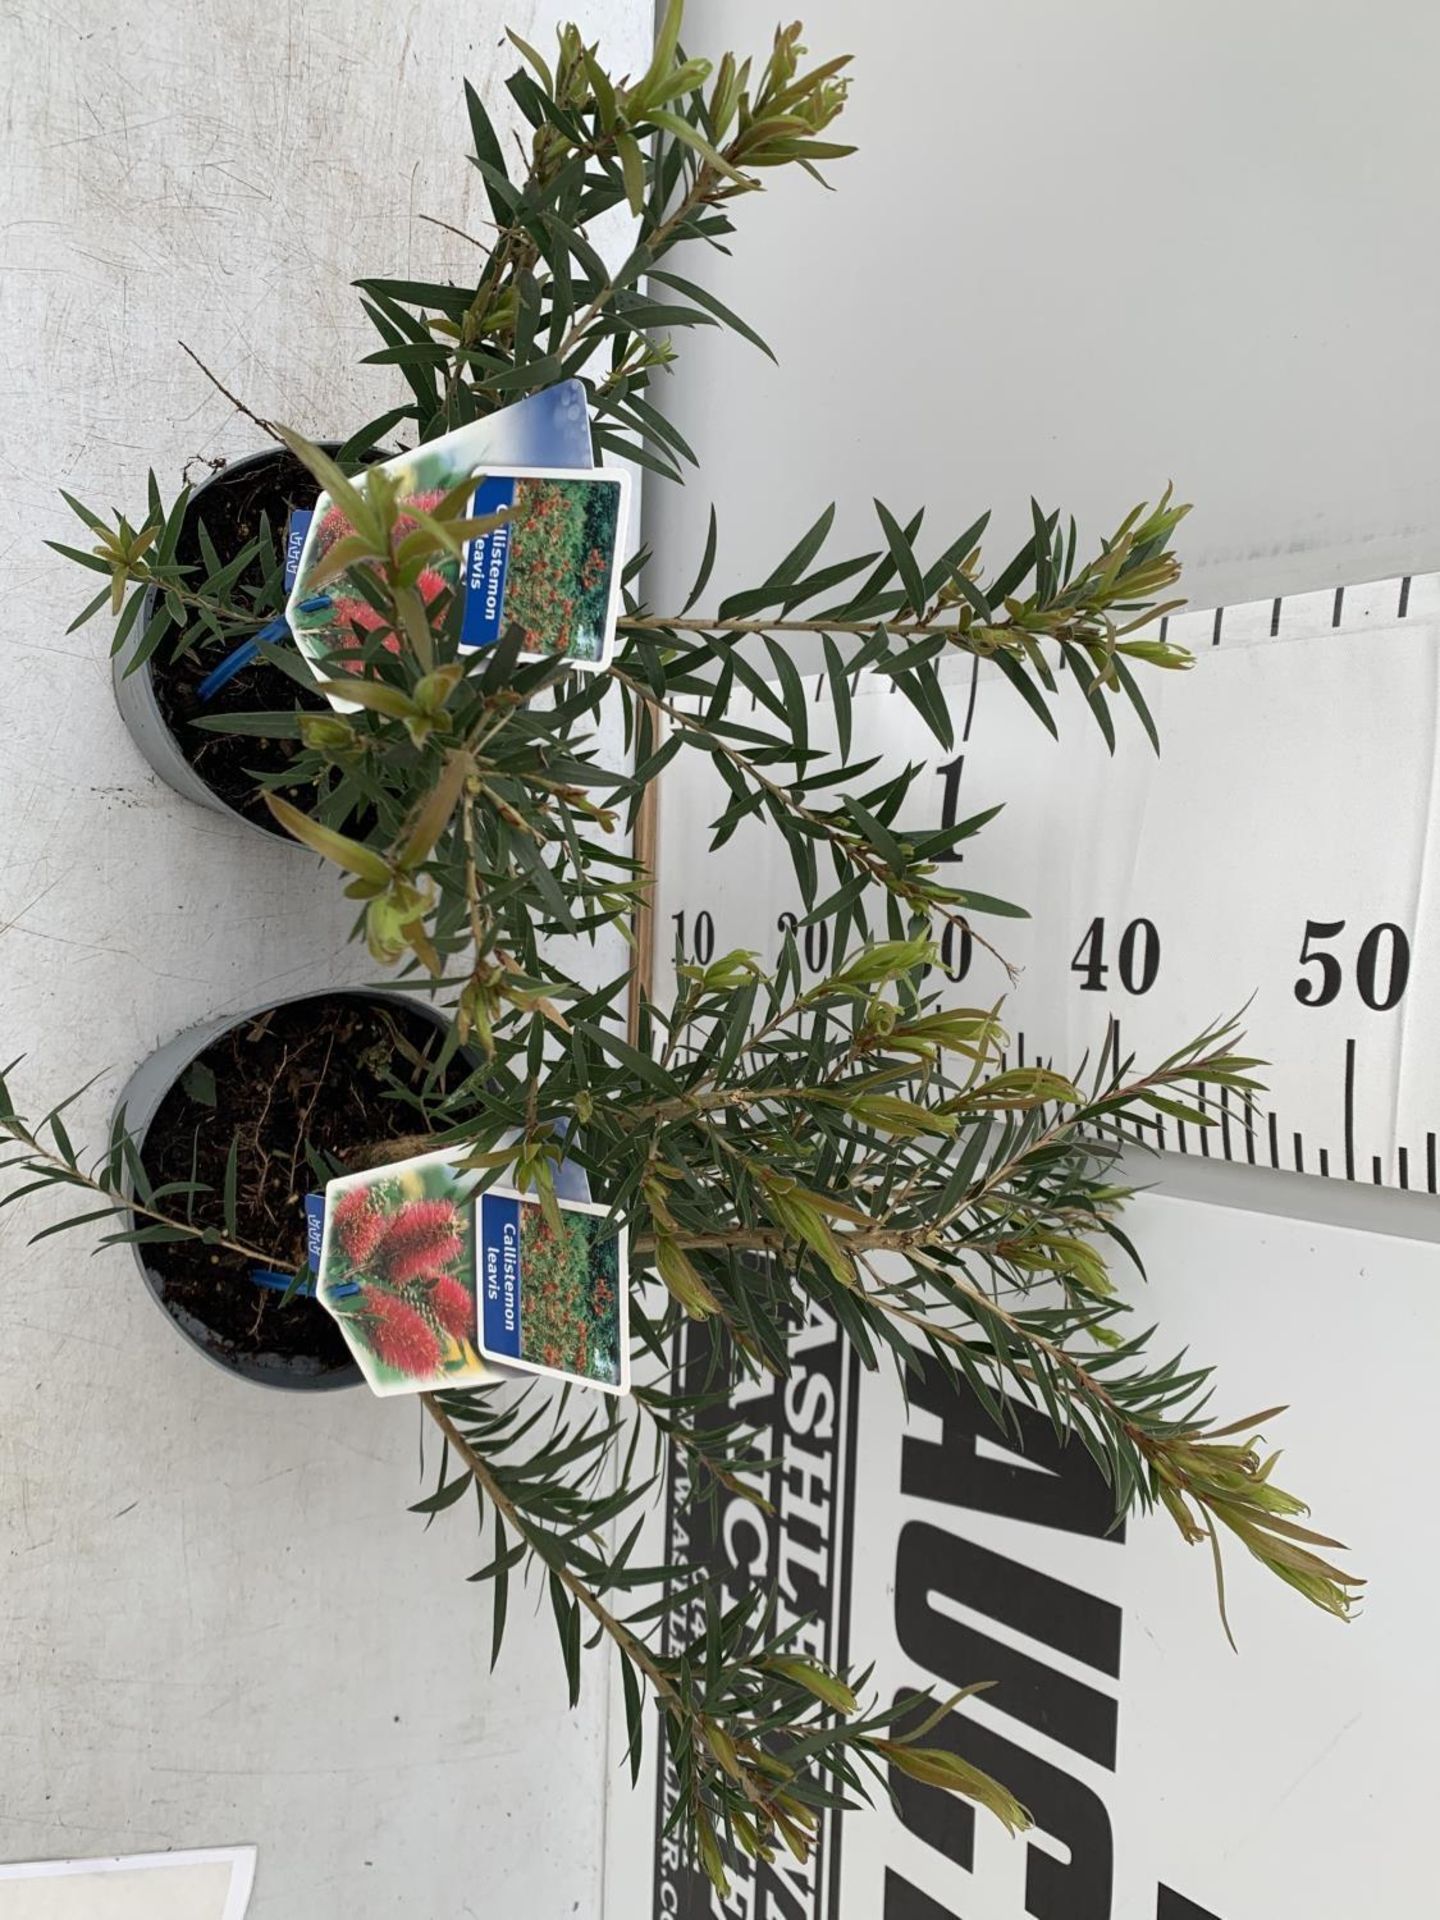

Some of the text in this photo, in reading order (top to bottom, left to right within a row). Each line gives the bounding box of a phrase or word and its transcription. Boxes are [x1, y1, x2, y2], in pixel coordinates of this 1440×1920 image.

[484, 504, 508, 621] Cllistemon
[928, 755, 964, 862] 1
[670, 910, 715, 966] 10
[906, 914, 973, 983] 0
[1070, 917, 1160, 996] 40
[1294, 920, 1410, 1012] 50
[486, 1246, 500, 1300] leavis
[503, 1222, 517, 1331] Callistemon
[884, 1345, 1128, 1920] AUC
